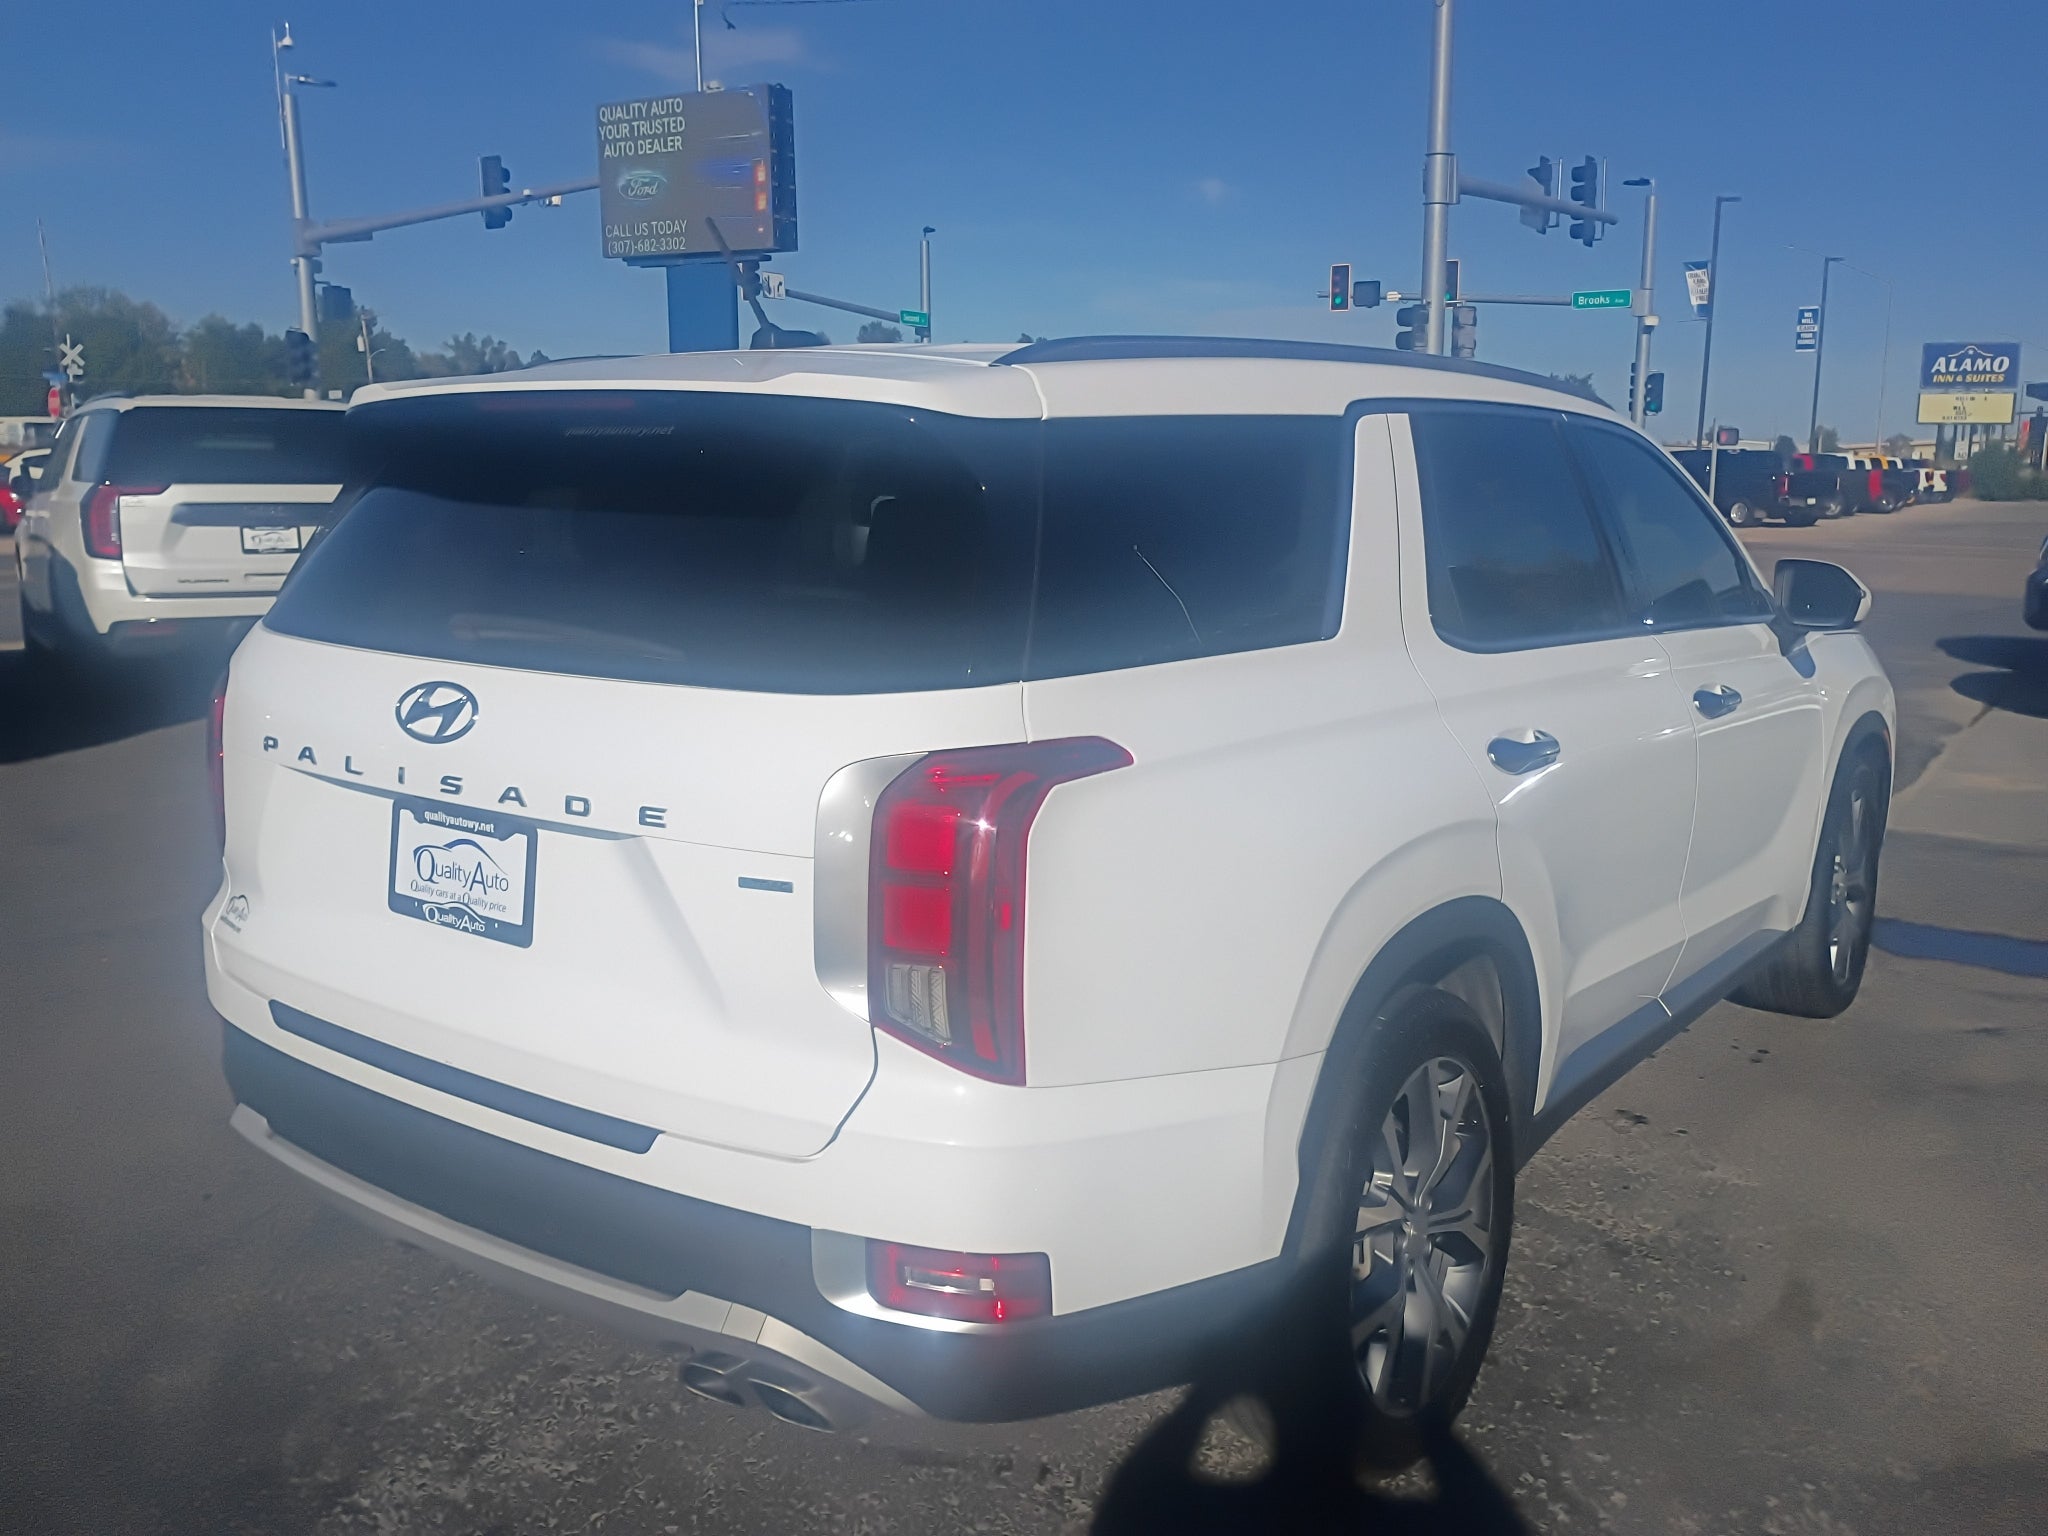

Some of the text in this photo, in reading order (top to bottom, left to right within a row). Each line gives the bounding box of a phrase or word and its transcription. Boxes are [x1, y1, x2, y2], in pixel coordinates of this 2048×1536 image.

[599, 98, 683, 123] QUALITY AUTO
[599, 117, 685, 141] YOUR TRUSTED
[604, 136, 683, 158] AUTO DEALER
[628, 177, 658, 196] Ford
[605, 220, 687, 238] CALL US TODAY
[608, 237, 686, 255] (307)-682-3302
[1578, 295, 1610, 305] Brooks
[1931, 356, 2010, 373] ALAMO
[1933, 373, 1954, 383] INN
[1965, 373, 2005, 383] SUITES
[262, 735, 668, 829] PALISADE
[424, 811, 494, 833] qualityautowy.net
[410, 879, 435, 897] Quality
[435, 887, 449, 899] cars
[462, 891, 489, 909] Quality
